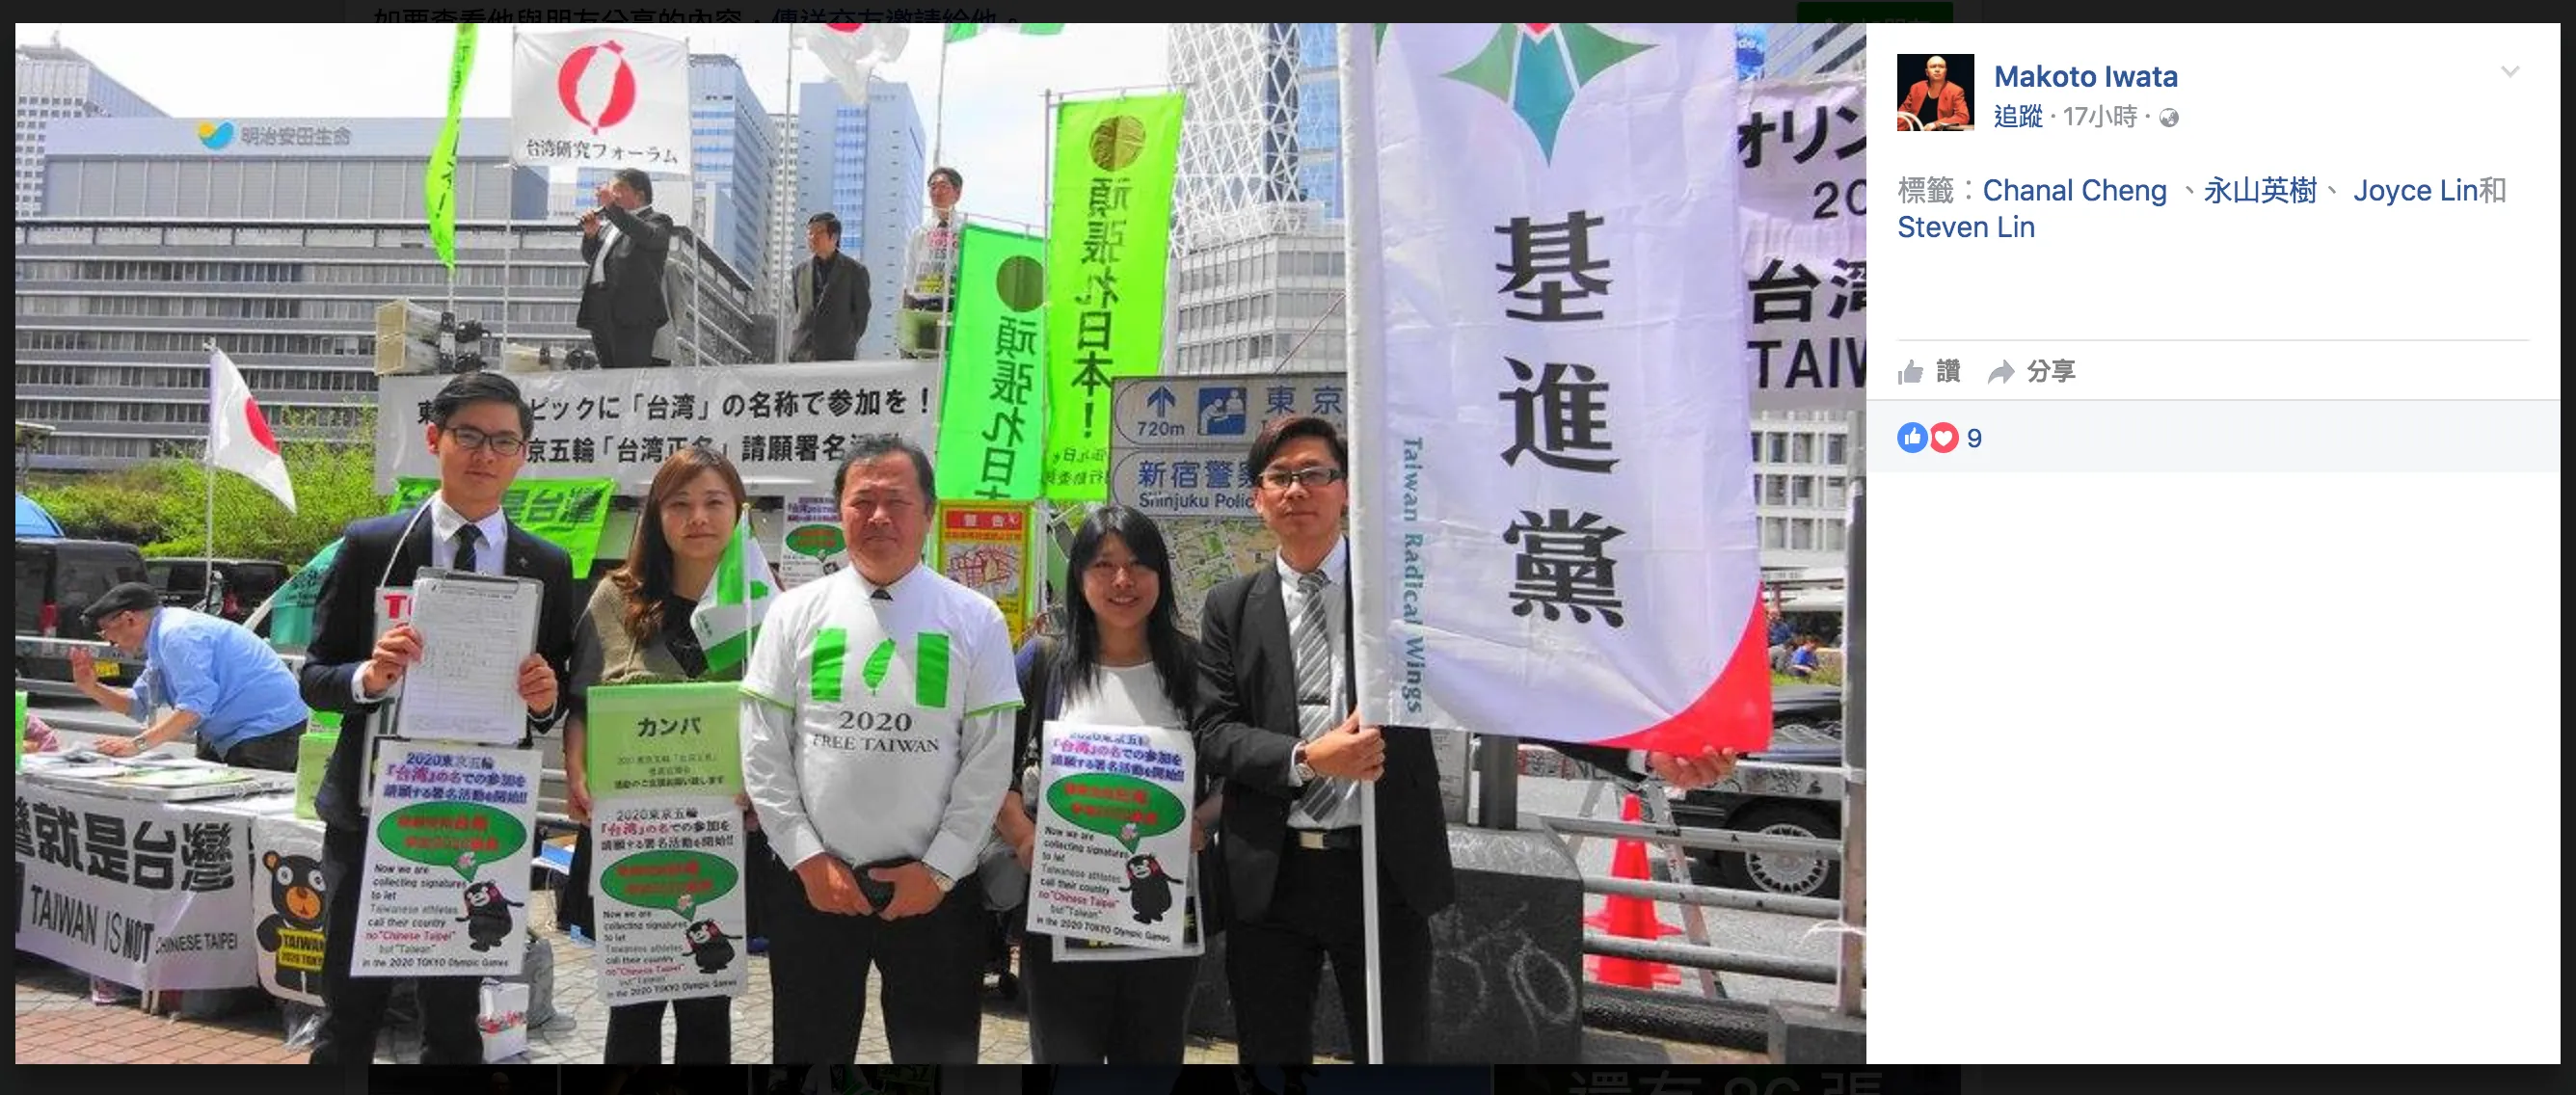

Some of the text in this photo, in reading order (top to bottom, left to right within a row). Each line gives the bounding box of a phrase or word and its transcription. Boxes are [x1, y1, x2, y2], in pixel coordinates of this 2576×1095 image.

[241, 126, 352, 146] 明治安田生命
[525, 139, 679, 164] 台湾研究フォーラム
[1266, 385, 1344, 415] 東京
[1493, 210, 1625, 629] 基進黨
[1138, 421, 1185, 437] 720m
[1139, 494, 1209, 511] Shinjuku
[1402, 437, 1426, 714] Taiwan Radical Wings
[839, 710, 913, 732] 2020
[813, 734, 939, 754] FREE TAIWAN
[1044, 826, 1061, 837] Now
[1044, 840, 1130, 860] collecting signatures
[374, 864, 394, 874] Now
[372, 878, 468, 891] collecting signatures
[30, 884, 238, 963] TAIWAN IS NOT CHINESE TAIPEI
[603, 910, 621, 919] Now
[388, 919, 408, 927] their
[412, 920, 446, 929] country
[646, 921, 687, 930] signatures
[389, 957, 414, 968] 2020
